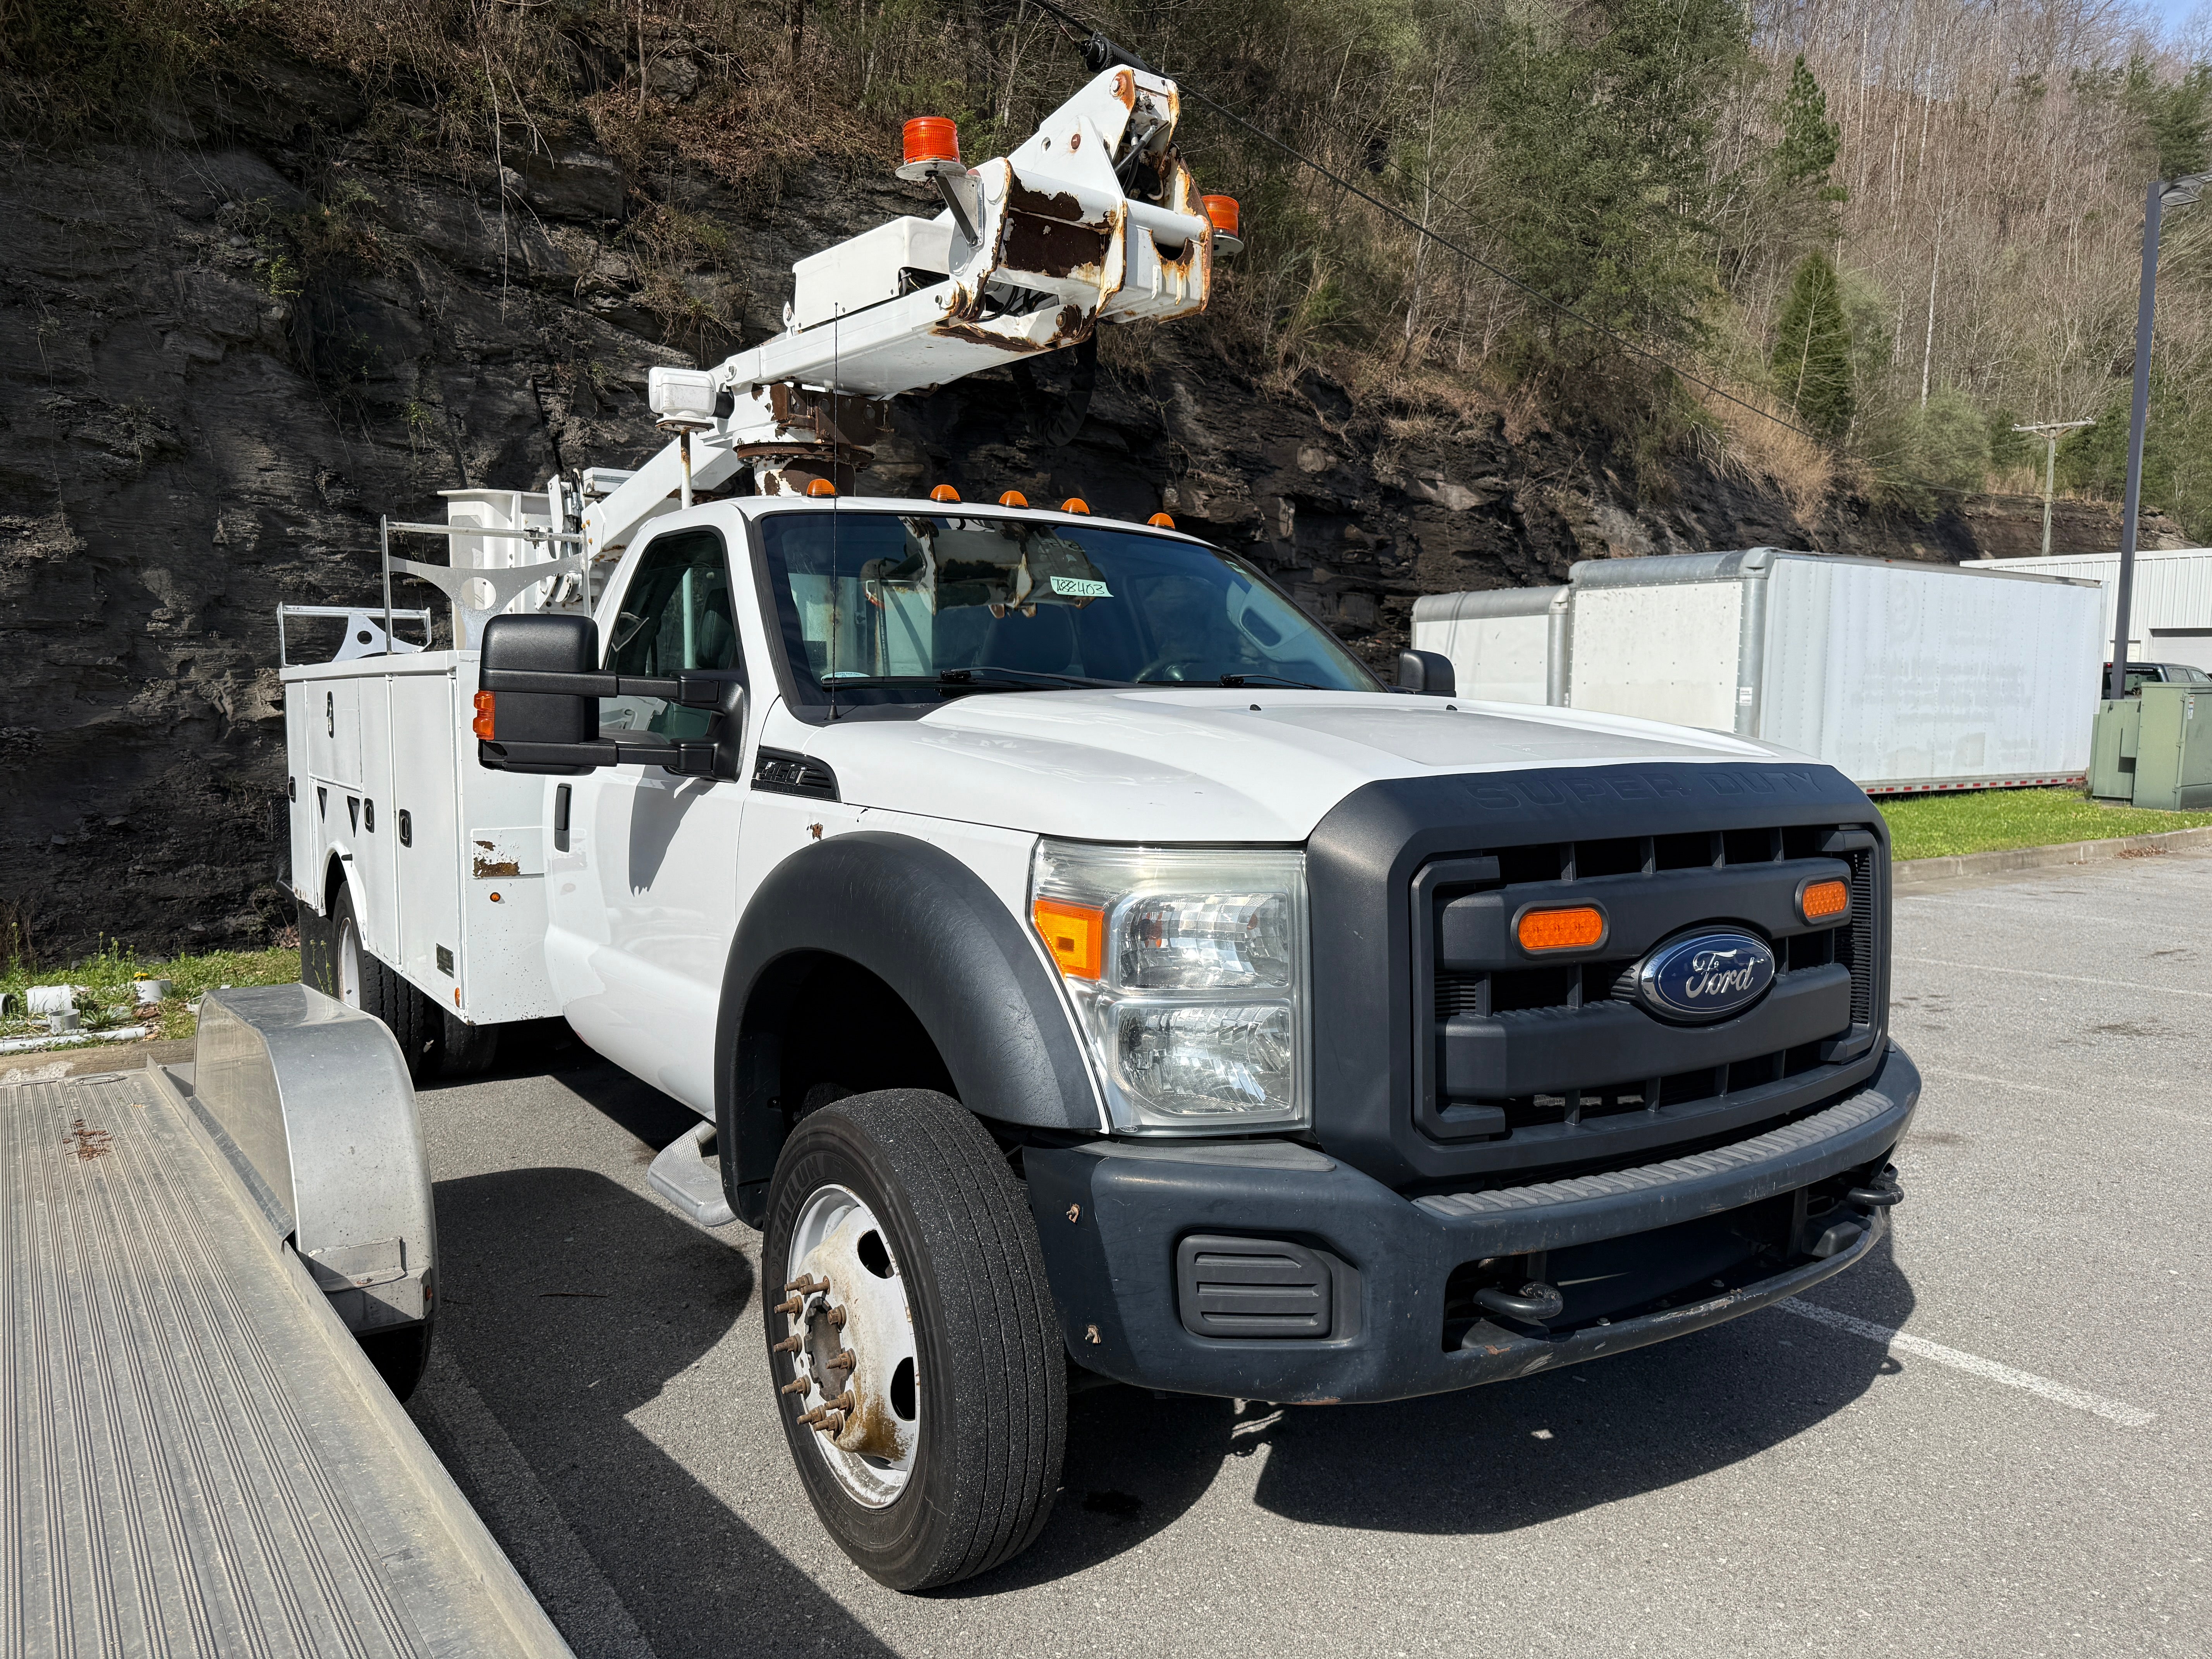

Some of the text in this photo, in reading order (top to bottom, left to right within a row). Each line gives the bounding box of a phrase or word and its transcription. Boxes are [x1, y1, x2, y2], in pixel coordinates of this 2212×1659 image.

[1465, 772, 1822, 810] SUPER DUTY
[1685, 949, 1753, 998] Ford
[773, 1154, 822, 1257] SAILUN
